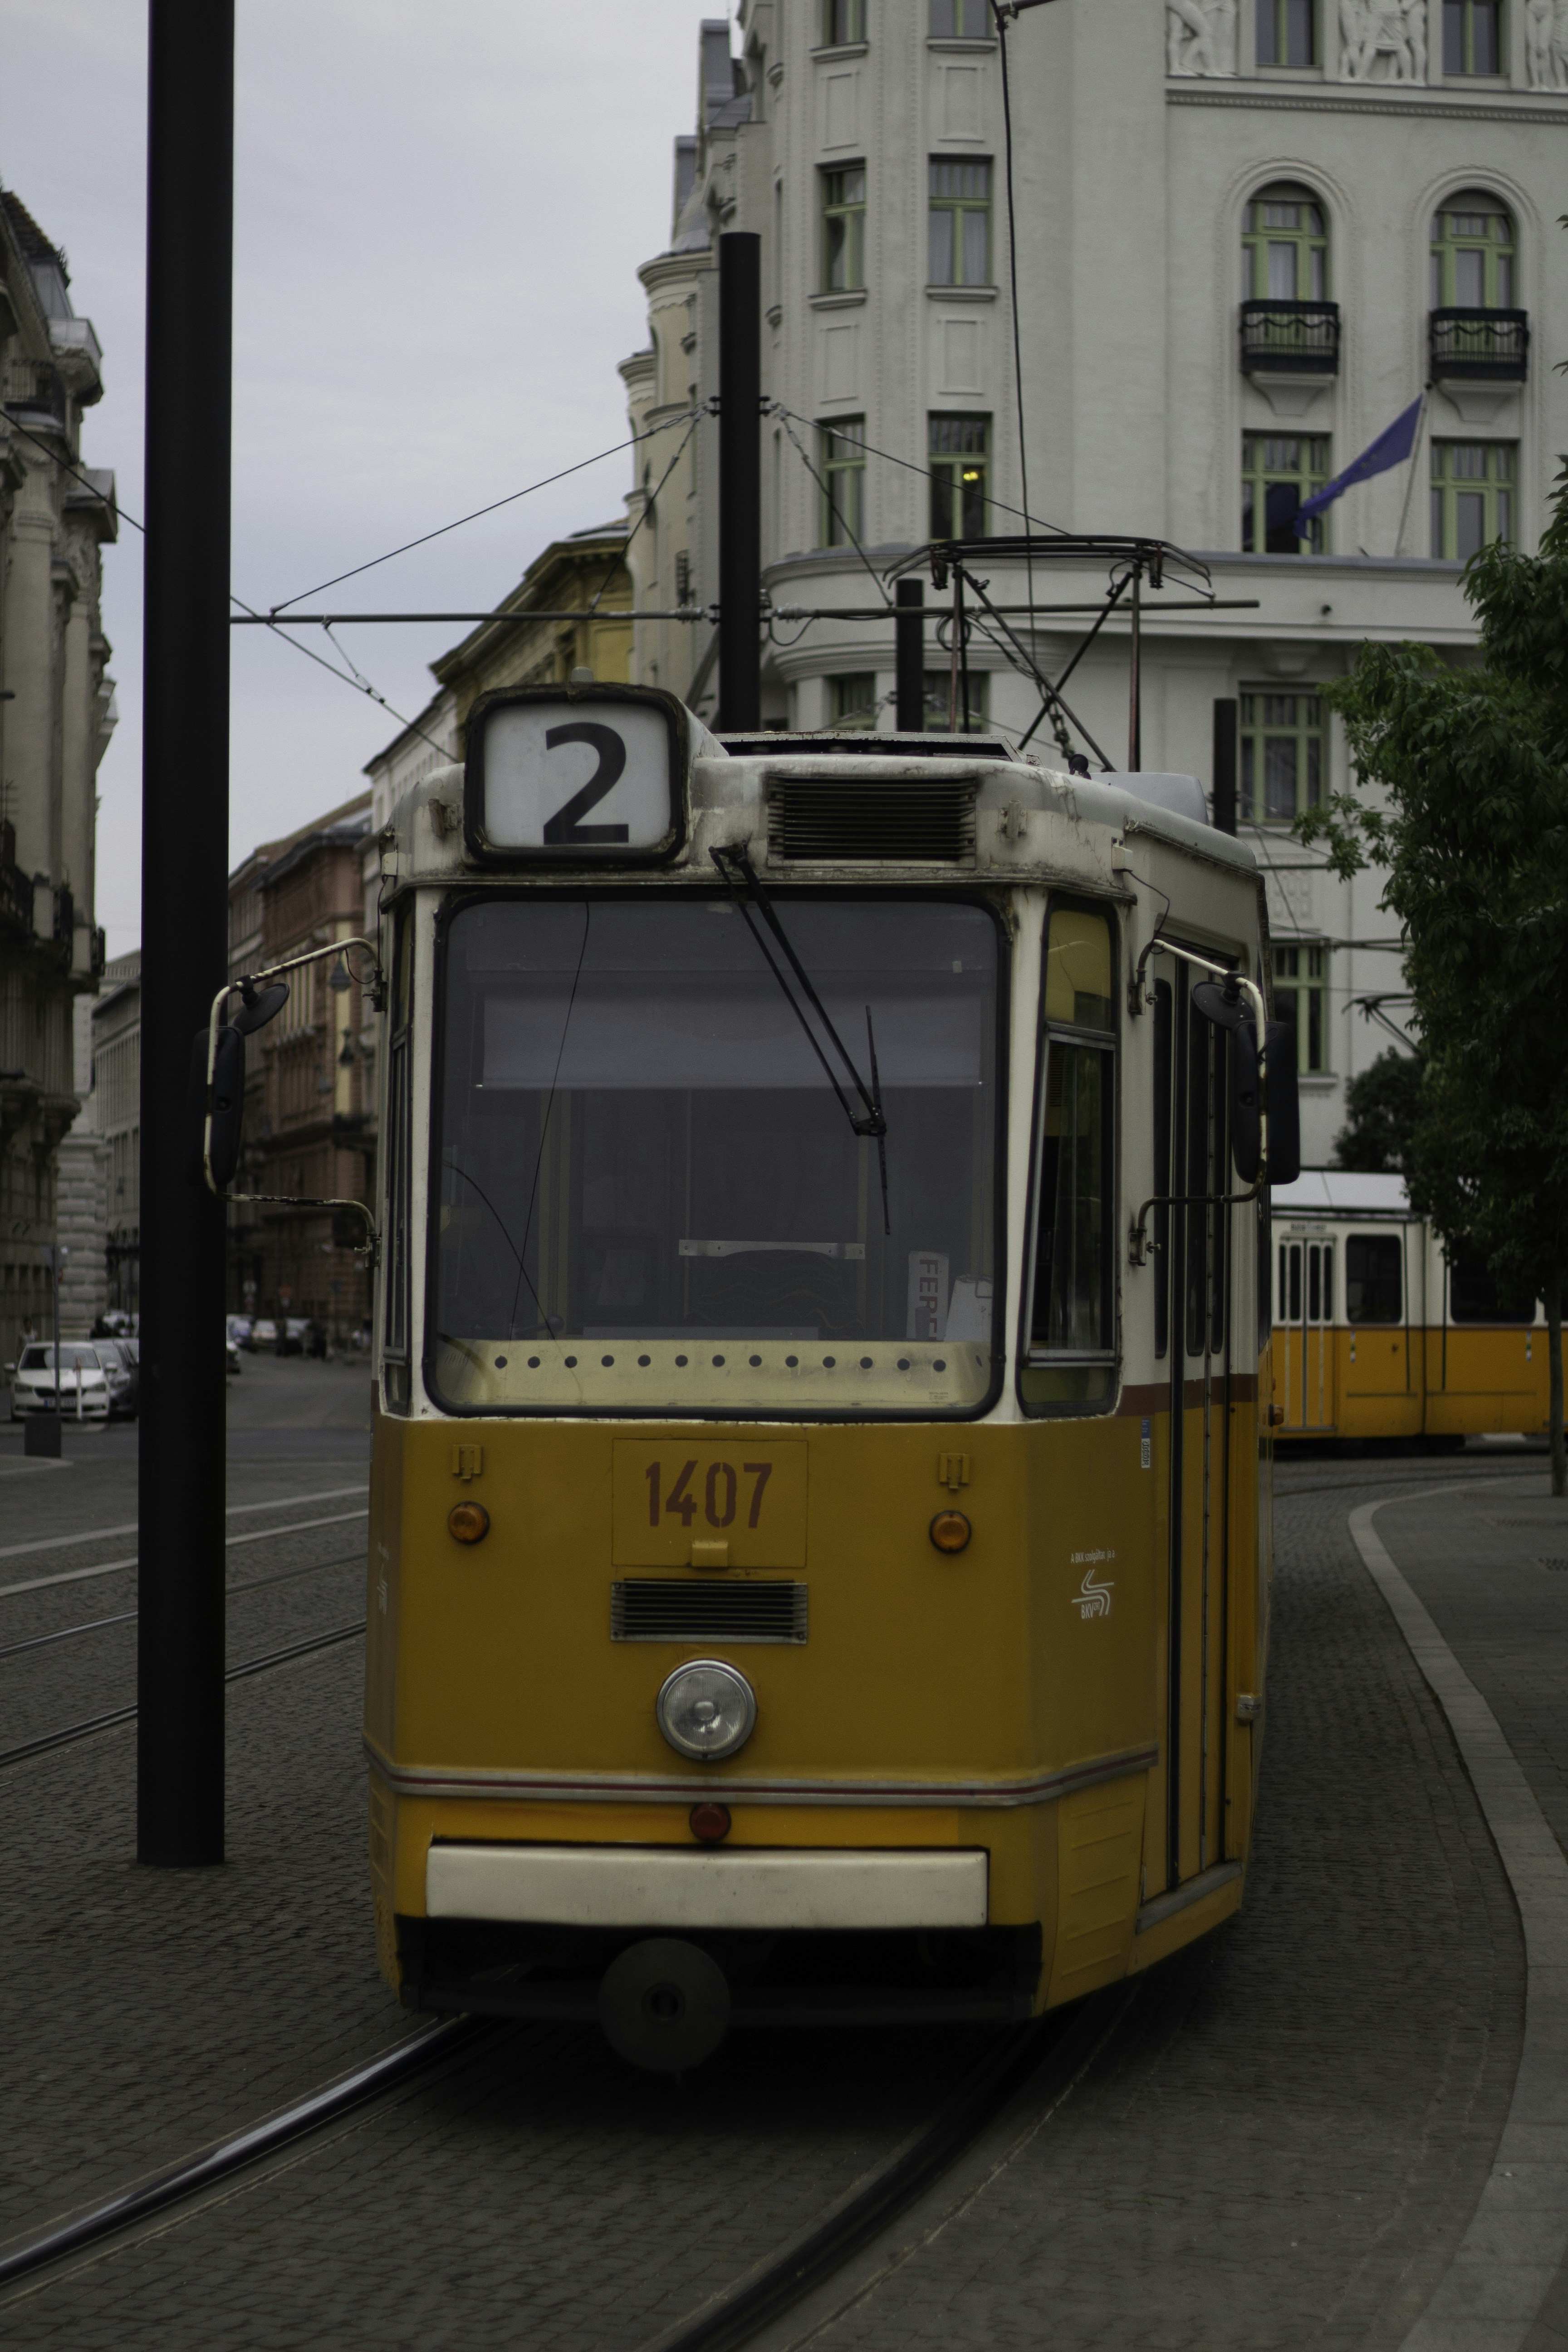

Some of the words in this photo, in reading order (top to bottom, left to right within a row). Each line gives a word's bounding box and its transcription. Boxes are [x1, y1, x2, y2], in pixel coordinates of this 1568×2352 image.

[544, 722, 629, 845] 2
[645, 1460, 773, 1529] 1407
[1081, 1603, 1093, 1619] BKV
